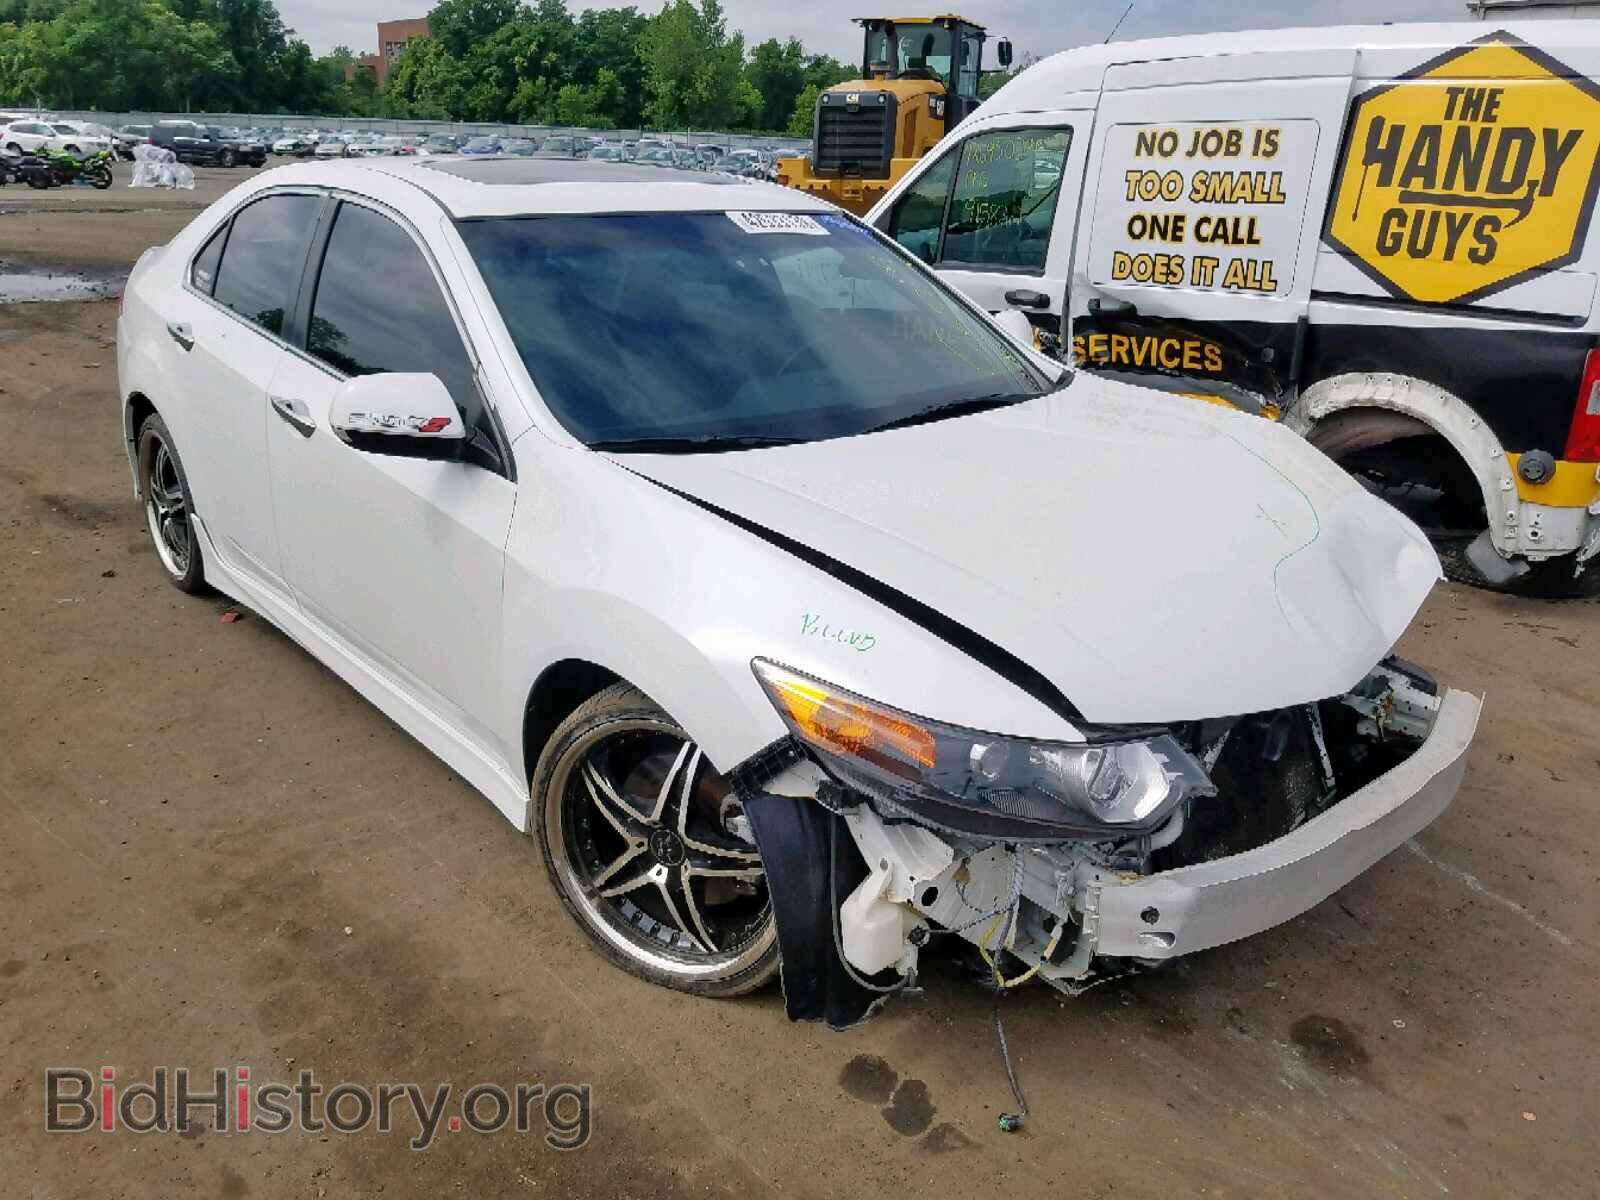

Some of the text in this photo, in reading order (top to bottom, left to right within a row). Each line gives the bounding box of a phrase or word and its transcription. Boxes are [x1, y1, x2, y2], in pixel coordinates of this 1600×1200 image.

[1443, 87, 1504, 122] THE
[1134, 129, 1280, 158] NO JOB IS
[1362, 115, 1584, 198] HANDY
[1125, 170, 1286, 204] TOO SMALL
[1127, 214, 1260, 245] ONE CALL
[1375, 208, 1502, 265] GUYS
[1112, 251, 1278, 292] DOES IT ALL
[1071, 333, 1223, 372] SERVICES
